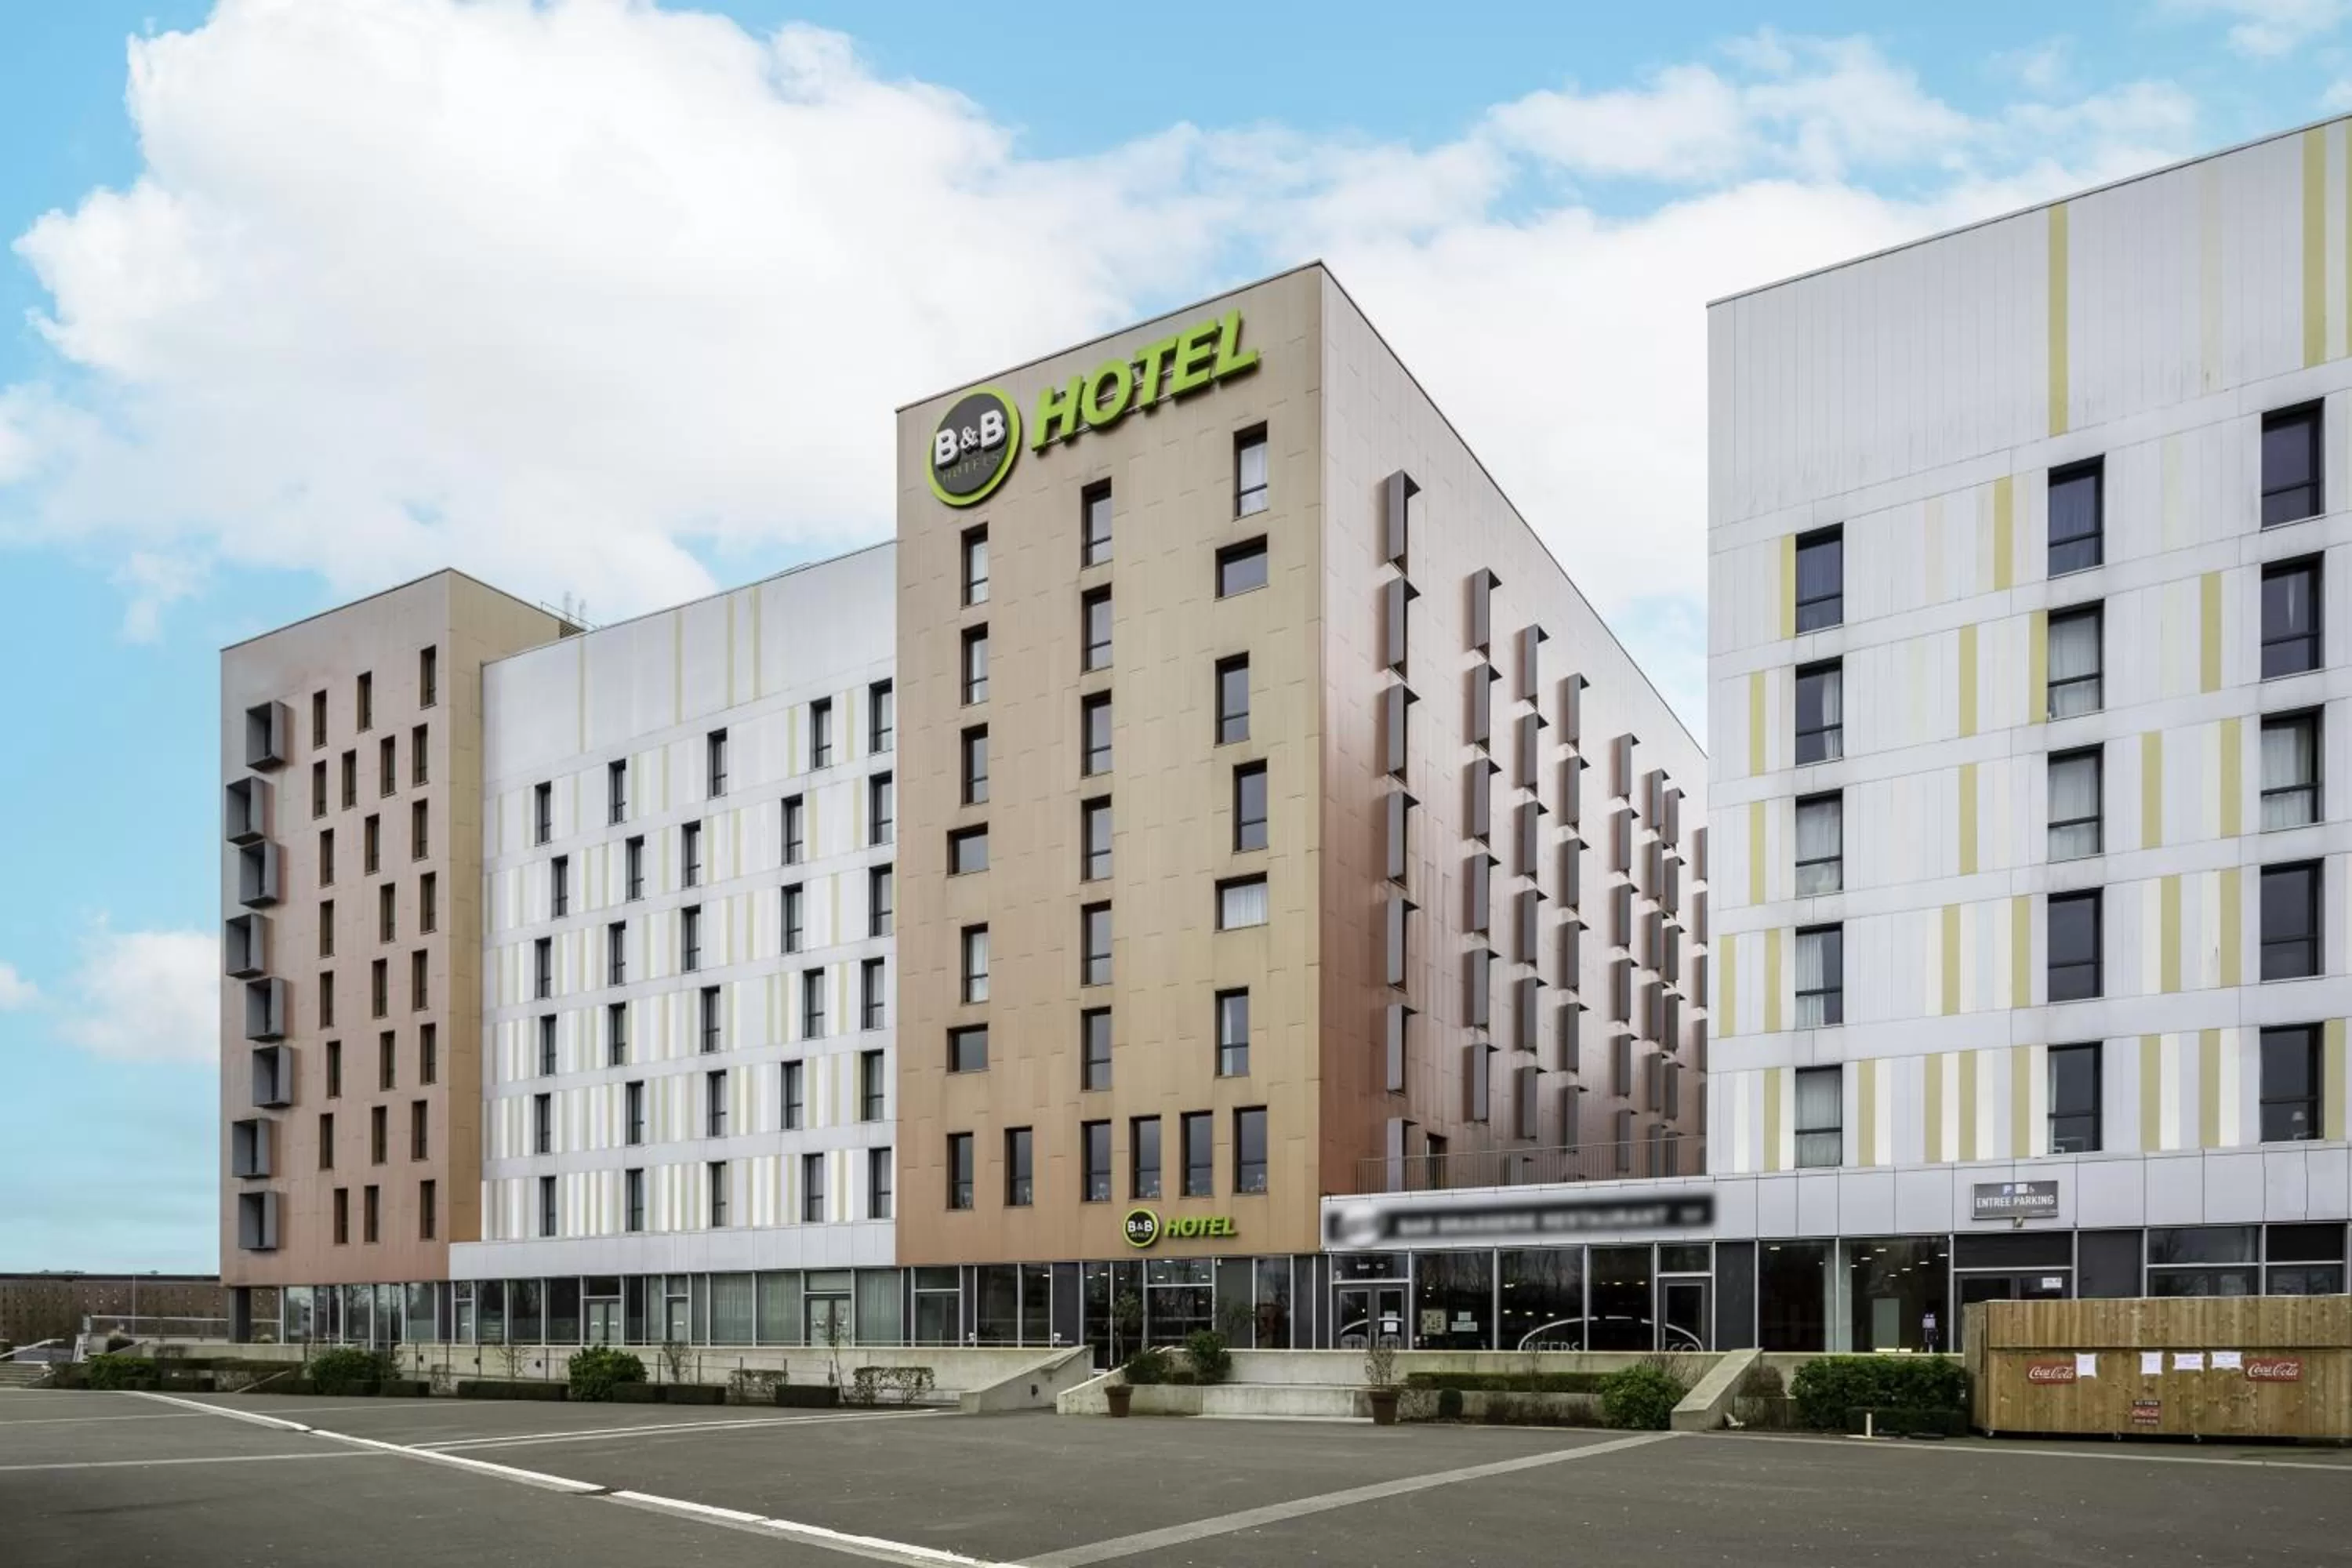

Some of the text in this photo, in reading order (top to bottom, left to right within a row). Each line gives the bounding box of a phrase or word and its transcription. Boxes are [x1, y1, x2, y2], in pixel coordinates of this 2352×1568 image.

[1032, 309, 1258, 452] HOTEL
[935, 409, 1007, 468] B&B
[2013, 1194, 2055, 1206] PARKING
[1127, 1220, 1153, 1232] B&B
[1163, 1216, 1237, 1237] HOTEL
